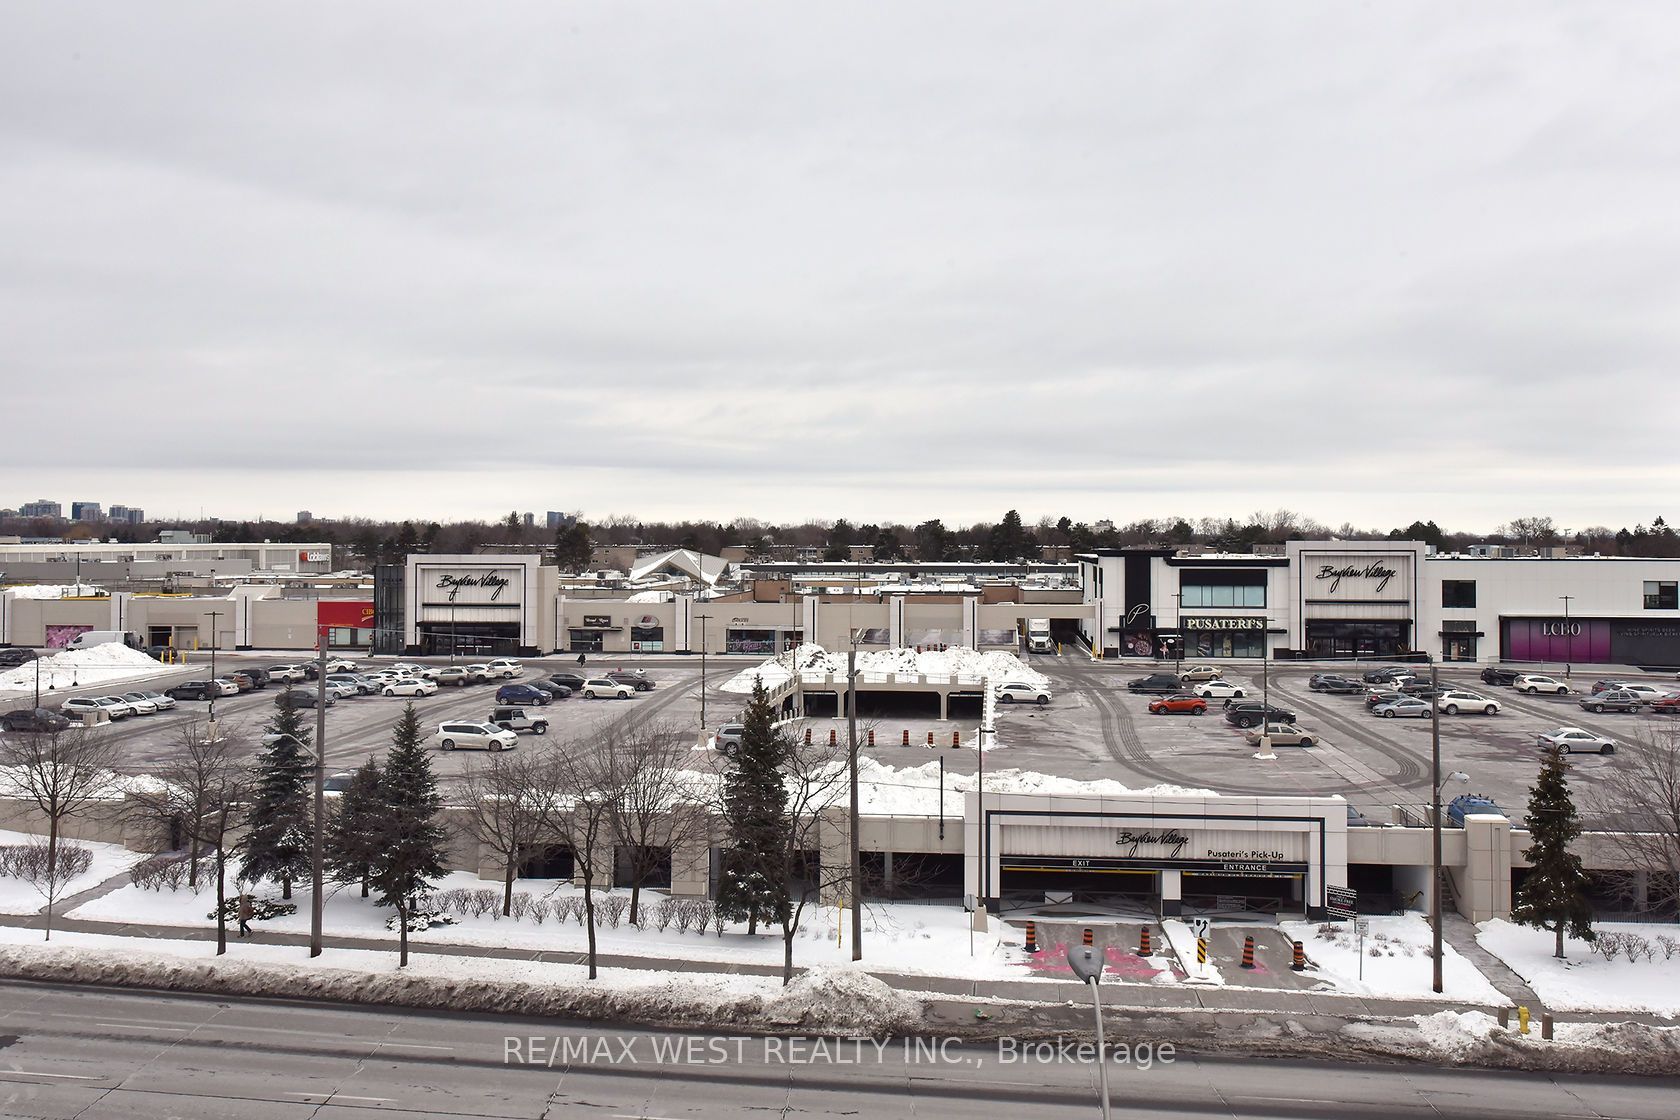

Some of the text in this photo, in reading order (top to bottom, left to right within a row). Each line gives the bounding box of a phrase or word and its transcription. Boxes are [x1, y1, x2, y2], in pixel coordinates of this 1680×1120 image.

[1362, 560, 1397, 593] Village
[479, 569, 509, 601] Village
[1187, 618, 1264, 630] PUSATERI'S
[1543, 622, 1581, 636] LCBO
[1159, 828, 1189, 858] Village
[1207, 849, 1284, 860] Pusateri's Pick-Up
[1223, 863, 1267, 871] ENTRANCE
